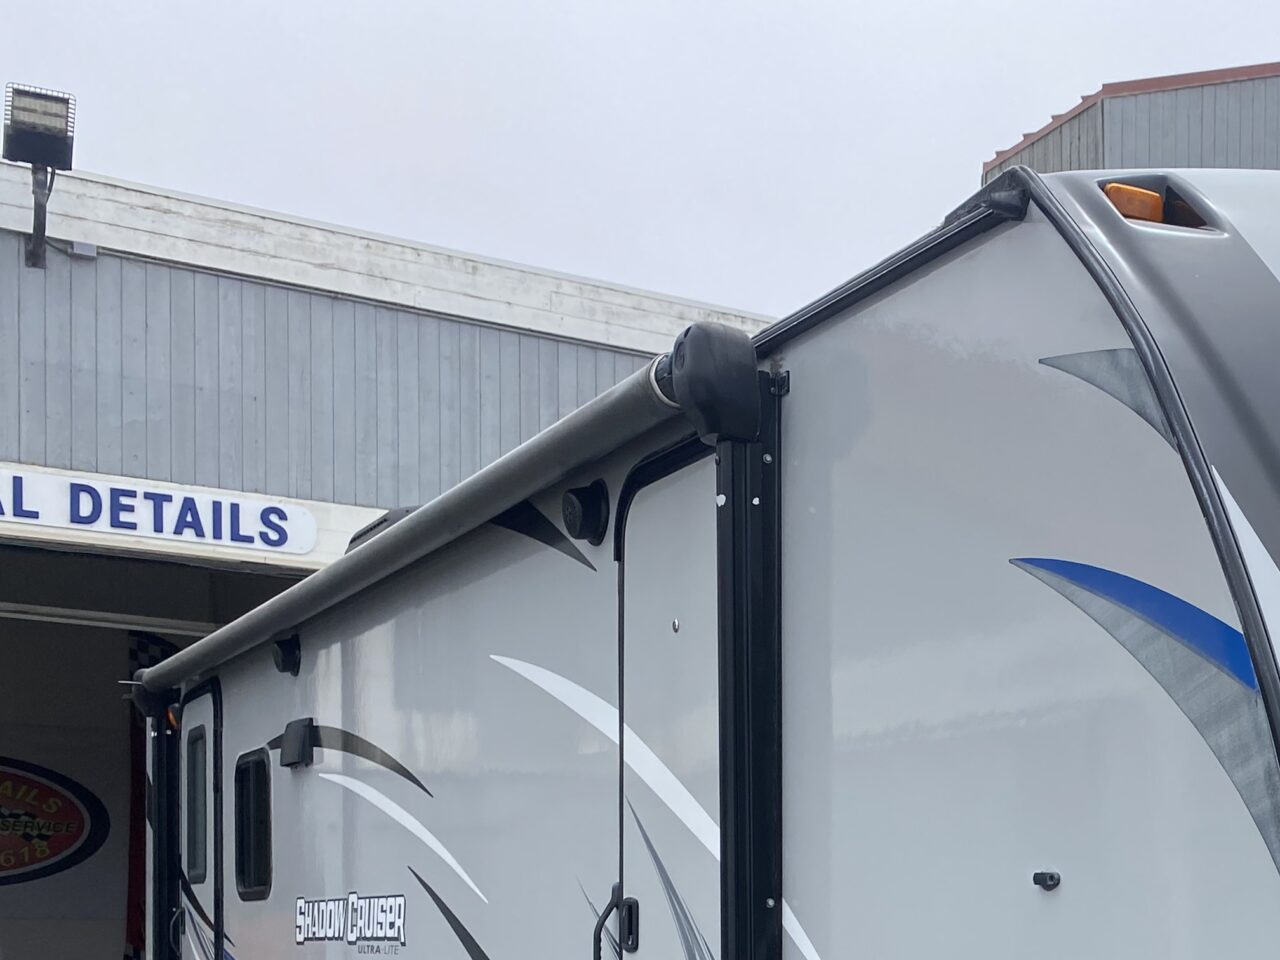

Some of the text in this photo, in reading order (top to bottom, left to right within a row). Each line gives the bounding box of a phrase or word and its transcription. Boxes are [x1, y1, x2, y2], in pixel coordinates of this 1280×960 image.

[0, 475, 289, 547] L DETAILS
[296, 897, 347, 945] SHADOW
